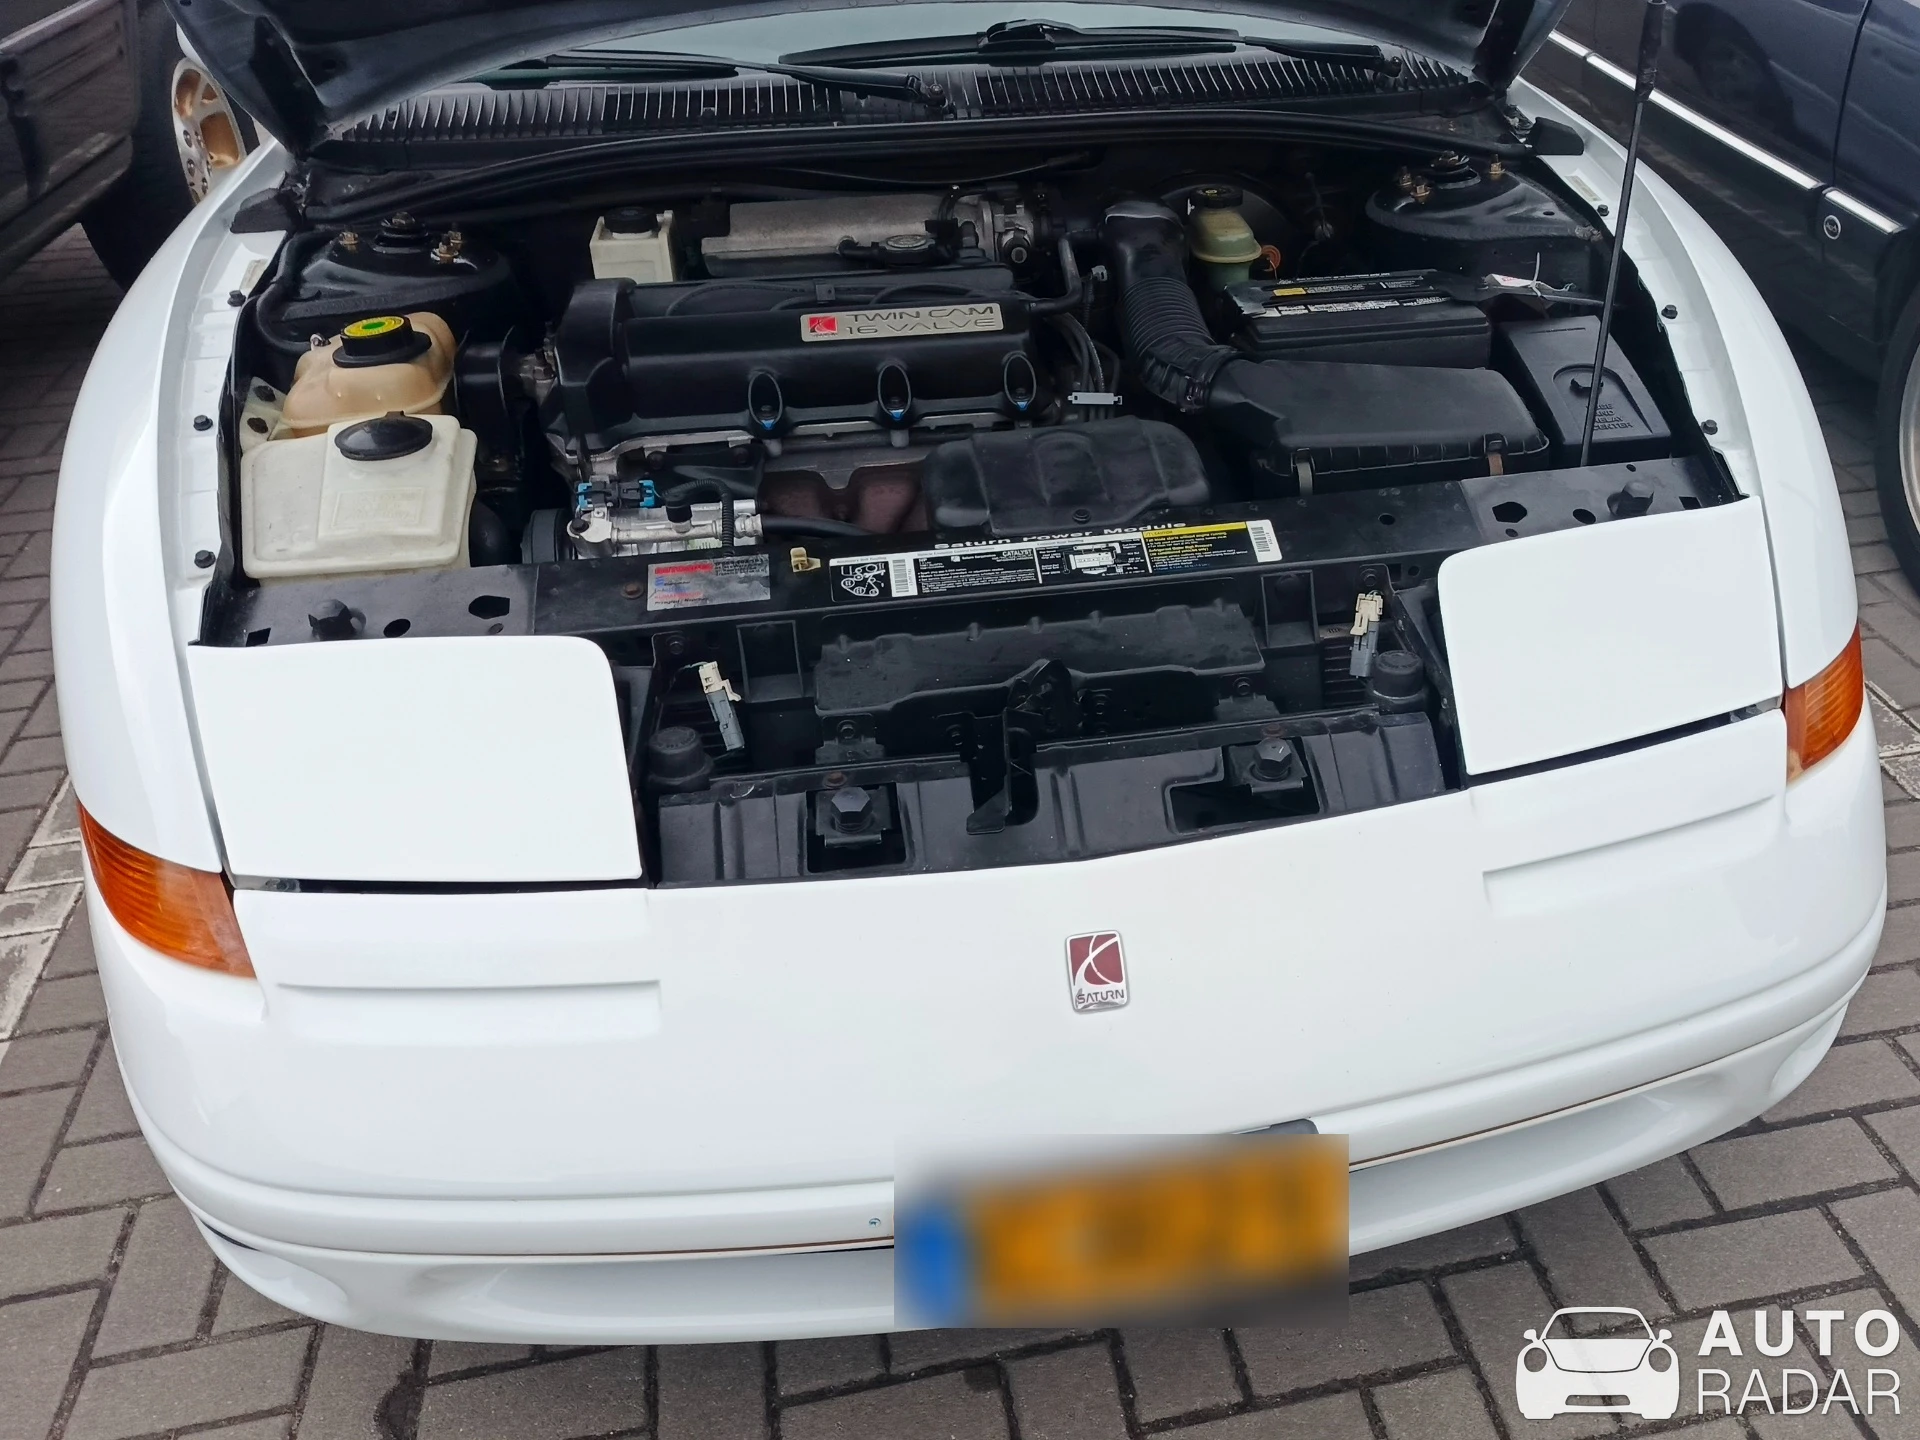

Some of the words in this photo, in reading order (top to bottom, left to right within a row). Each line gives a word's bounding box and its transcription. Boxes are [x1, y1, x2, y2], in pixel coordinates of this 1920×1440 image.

[846, 311, 920, 323] TWIN
[929, 306, 994, 318] CAM
[847, 324, 878, 335] 16
[887, 317, 996, 332] VALVE
[1103, 522, 1187, 535] Module
[1002, 549, 1033, 557] CATALYST
[1077, 989, 1124, 1004] SATURN
